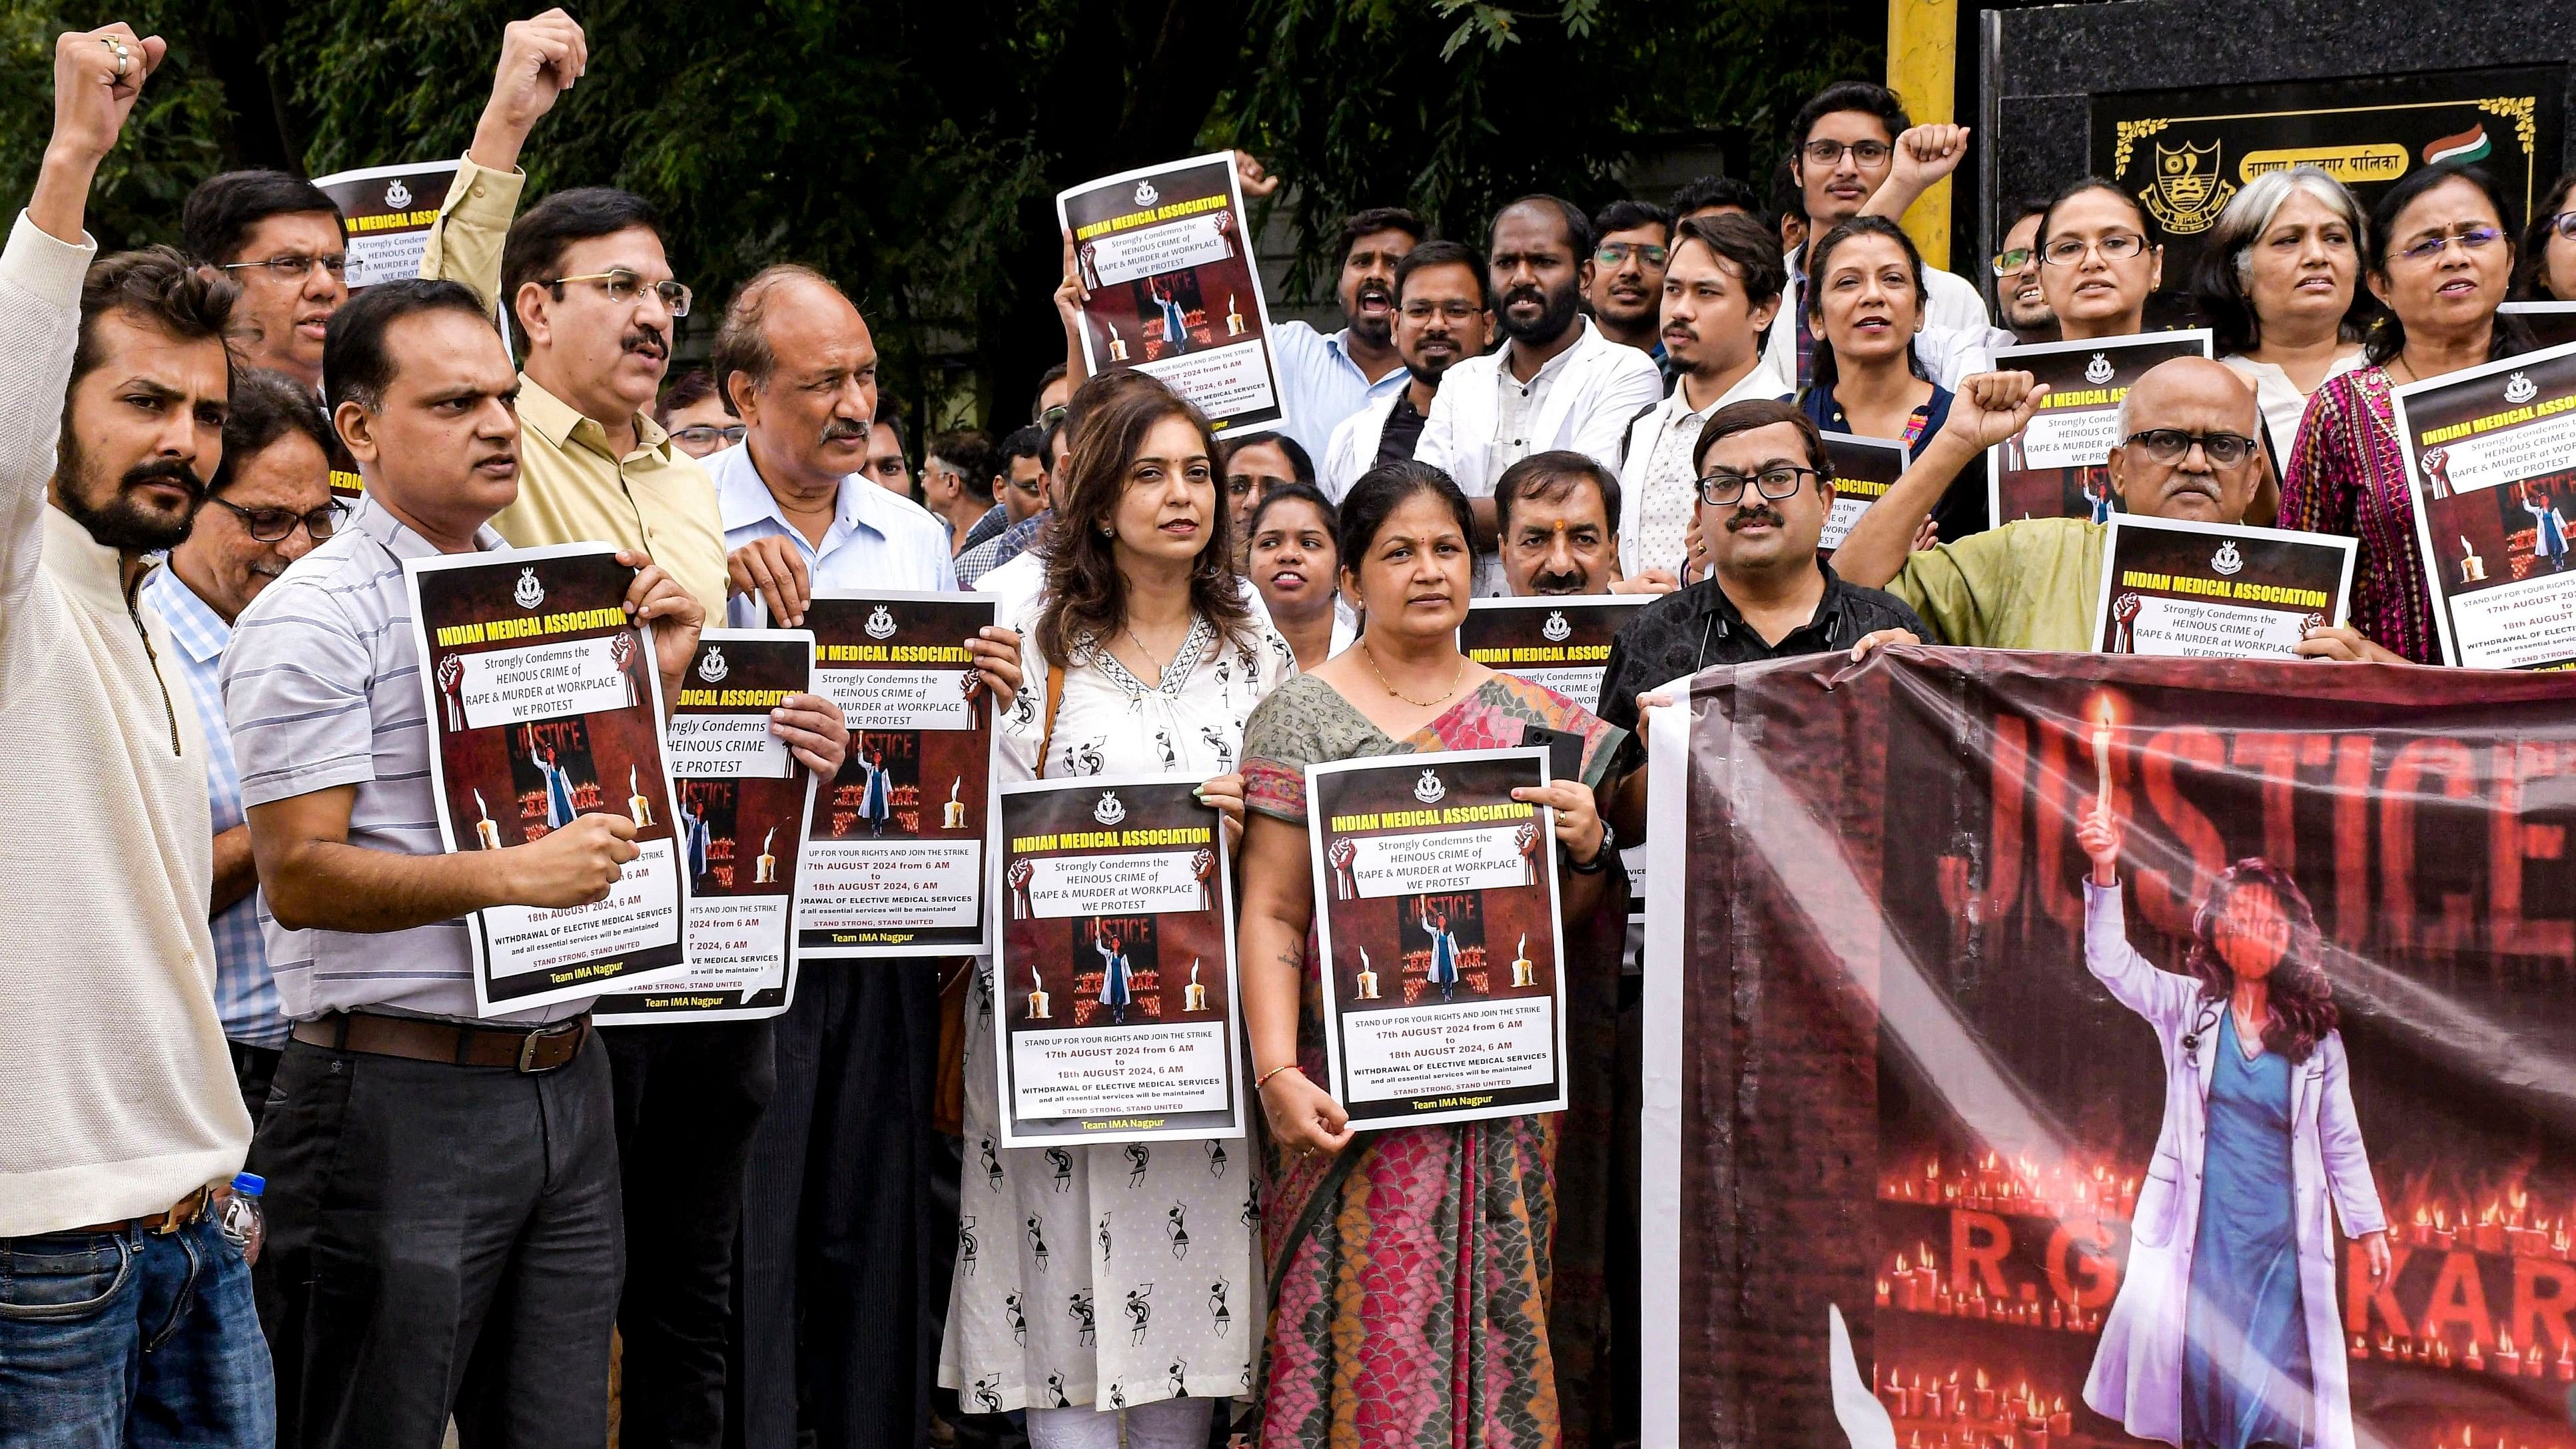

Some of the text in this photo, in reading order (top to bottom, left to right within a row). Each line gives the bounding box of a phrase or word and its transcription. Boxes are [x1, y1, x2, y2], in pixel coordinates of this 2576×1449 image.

[358, 213, 410, 231] MEDICAL
[1077, 195, 1226, 241] INDIAN MEDICAL ASSOCIATION
[2054, 390, 2108, 407] MEDICAL
[2421, 406, 2535, 446] INDIAN MEDICAL
[2122, 572, 2327, 607] INDIAN MEDICAL ASSOCIATION
[2162, 604, 2276, 624] Strongly Condemns the
[438, 608, 626, 645] INDIAN MEDICAL ASSOCIATION
[2172, 618, 2265, 639] HEINOUS CRIME of
[2136, 628, 2162, 638] RAPE
[2174, 632, 2218, 645] MURDER
[484, 646, 589, 669] Strongly Condemns the
[828, 645, 888, 661] MEDICAL
[1469, 649, 1509, 662] INDIAN
[1511, 646, 1564, 661] MEDICAL
[496, 663, 581, 684] HEINOUS CRIME of
[821, 674, 937, 686] Strongly Condemns the
[466, 676, 617, 706] RAPE & MURDER at WORKPLACE
[833, 688, 927, 700] HEINOUS CRIME of
[512, 699, 573, 716] WE PROTEST
[1332, 803, 1532, 831] INDIAN MEDICAL ASSOCIATION
[1013, 827, 1210, 852] INDIAN MEDICAL ASSOCIATION
[1378, 833, 1492, 851] Strongly Condemns the
[1938, 714, 2576, 958] JUSTICE
[1390, 847, 1482, 863] HEINOUS CRIME of
[1055, 857, 1168, 873] Strongly Condemns the
[1358, 869, 1383, 879] RAPE
[1386, 869, 1393, 877] &
[1396, 865, 1439, 876] MURDER
[1455, 859, 1517, 871] WORKPLACE
[1067, 871, 1158, 884] HEINOUS CRIME of
[1406, 876, 1470, 889] WE PROTEST
[1033, 890, 1059, 899] RAPE
[1061, 889, 1069, 898] &
[1072, 887, 1115, 897] MURDER
[1130, 884, 1192, 895] WORKPLACE
[1082, 900, 1146, 911] WE PROTEST
[494, 929, 548, 945] WITHDRAWAL
[564, 920, 599, 933] ELECTIVE
[602, 913, 634, 925] MEDICAL
[636, 906, 671, 919] SERVICES
[550, 961, 622, 982] Team IMA Nagpur
[1434, 1012, 1460, 1021] RIGHTS
[1401, 1027, 1442, 1037] AUGUST
[1446, 1024, 1470, 1033] 2024
[1070, 1048, 1112, 1057] AUGUST
[1414, 1046, 1455, 1057] AUGUST
[1458, 1044, 1485, 1053] 2024,
[1354, 1065, 1410, 1075] WITHDRAWAL
[1427, 1060, 1466, 1069] ELECTIVE
[1468, 1057, 1504, 1065] MEDICAL
[1507, 1053, 1546, 1061] SERVICES
[1492, 1064, 1531, 1073] maintained
[1439, 1097, 1458, 1107] IMA
[1459, 1095, 1492, 1106] Nagpur
[1129, 1119, 1163, 1128] Nagpur
